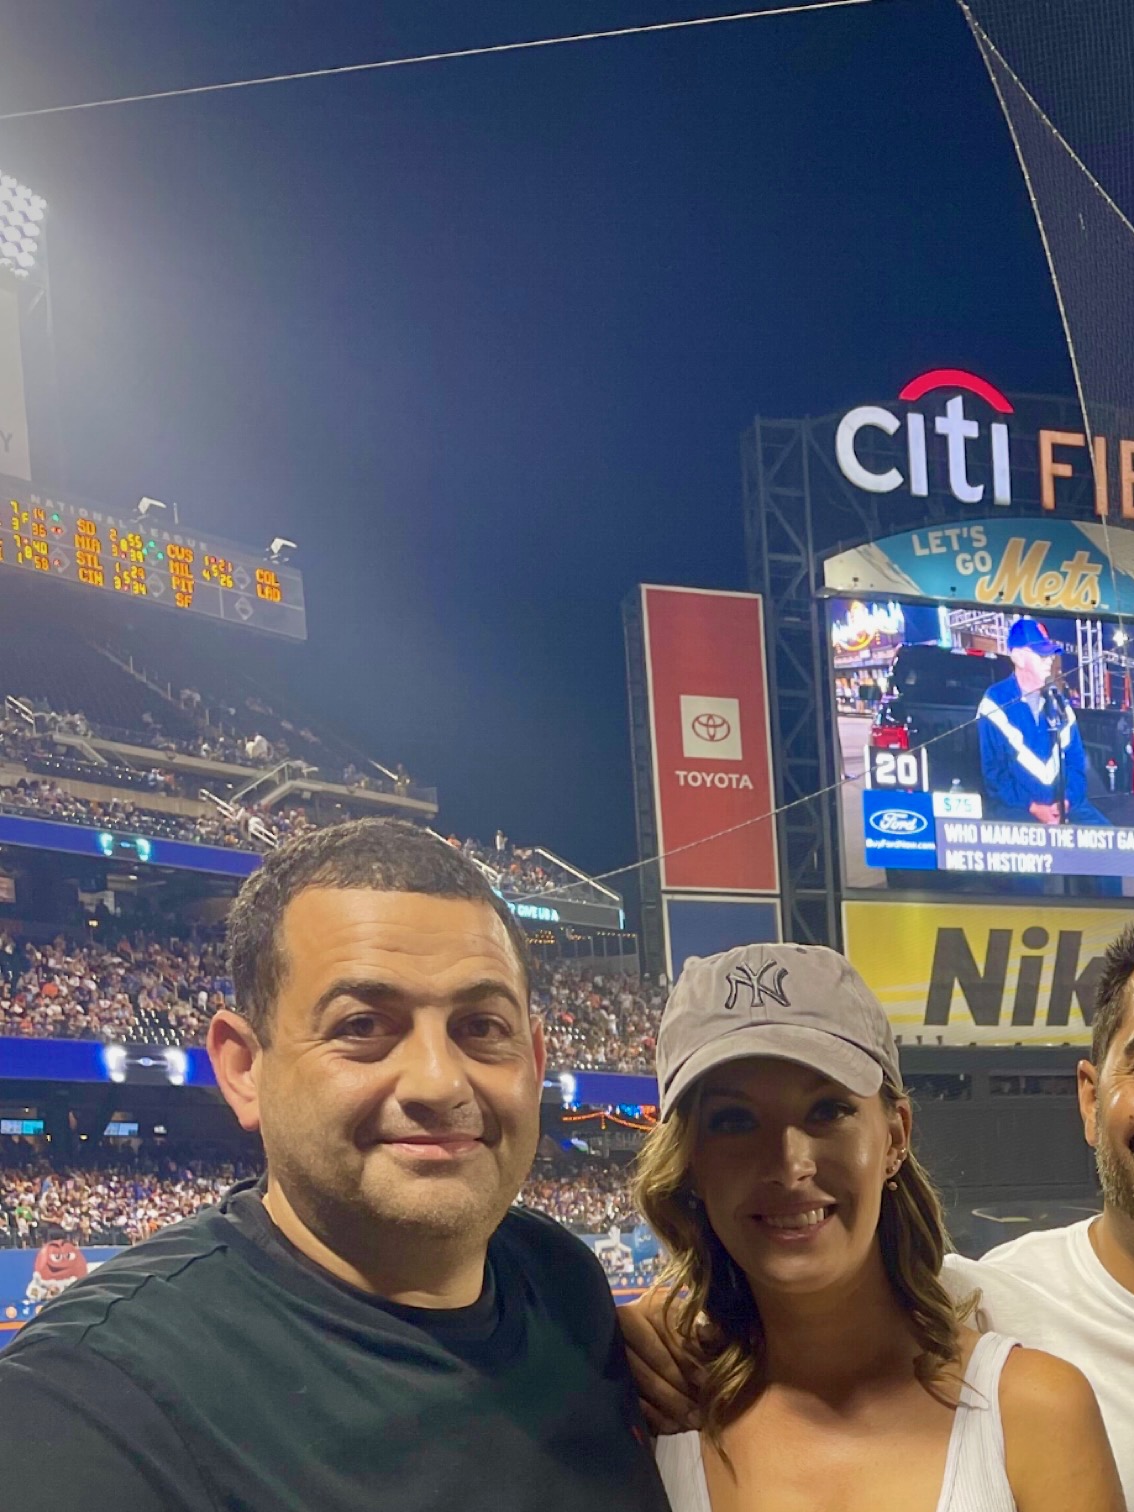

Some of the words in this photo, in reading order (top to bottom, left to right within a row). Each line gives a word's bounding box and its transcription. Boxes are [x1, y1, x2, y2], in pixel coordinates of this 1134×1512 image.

[77, 518, 96, 536] SD
[75, 534, 101, 553] MIA
[912, 525, 987, 557] LET'S
[76, 551, 103, 570] STL
[169, 560, 194, 578] MIL
[955, 550, 992, 576] GO
[255, 569, 280, 587] COL
[975, 537, 1106, 610] Mets
[875, 752, 918, 785] 20
[675, 771, 754, 789] TOYOTA
[944, 797, 972, 812] $75
[879, 812, 918, 831] Ford
[944, 824, 977, 843] WHO
[980, 825, 1047, 848] MANAGED
[1049, 828, 1074, 847] THE
[1077, 830, 1114, 849] MOST
[946, 851, 984, 870] METS
[986, 852, 1053, 873] HISTORY?
